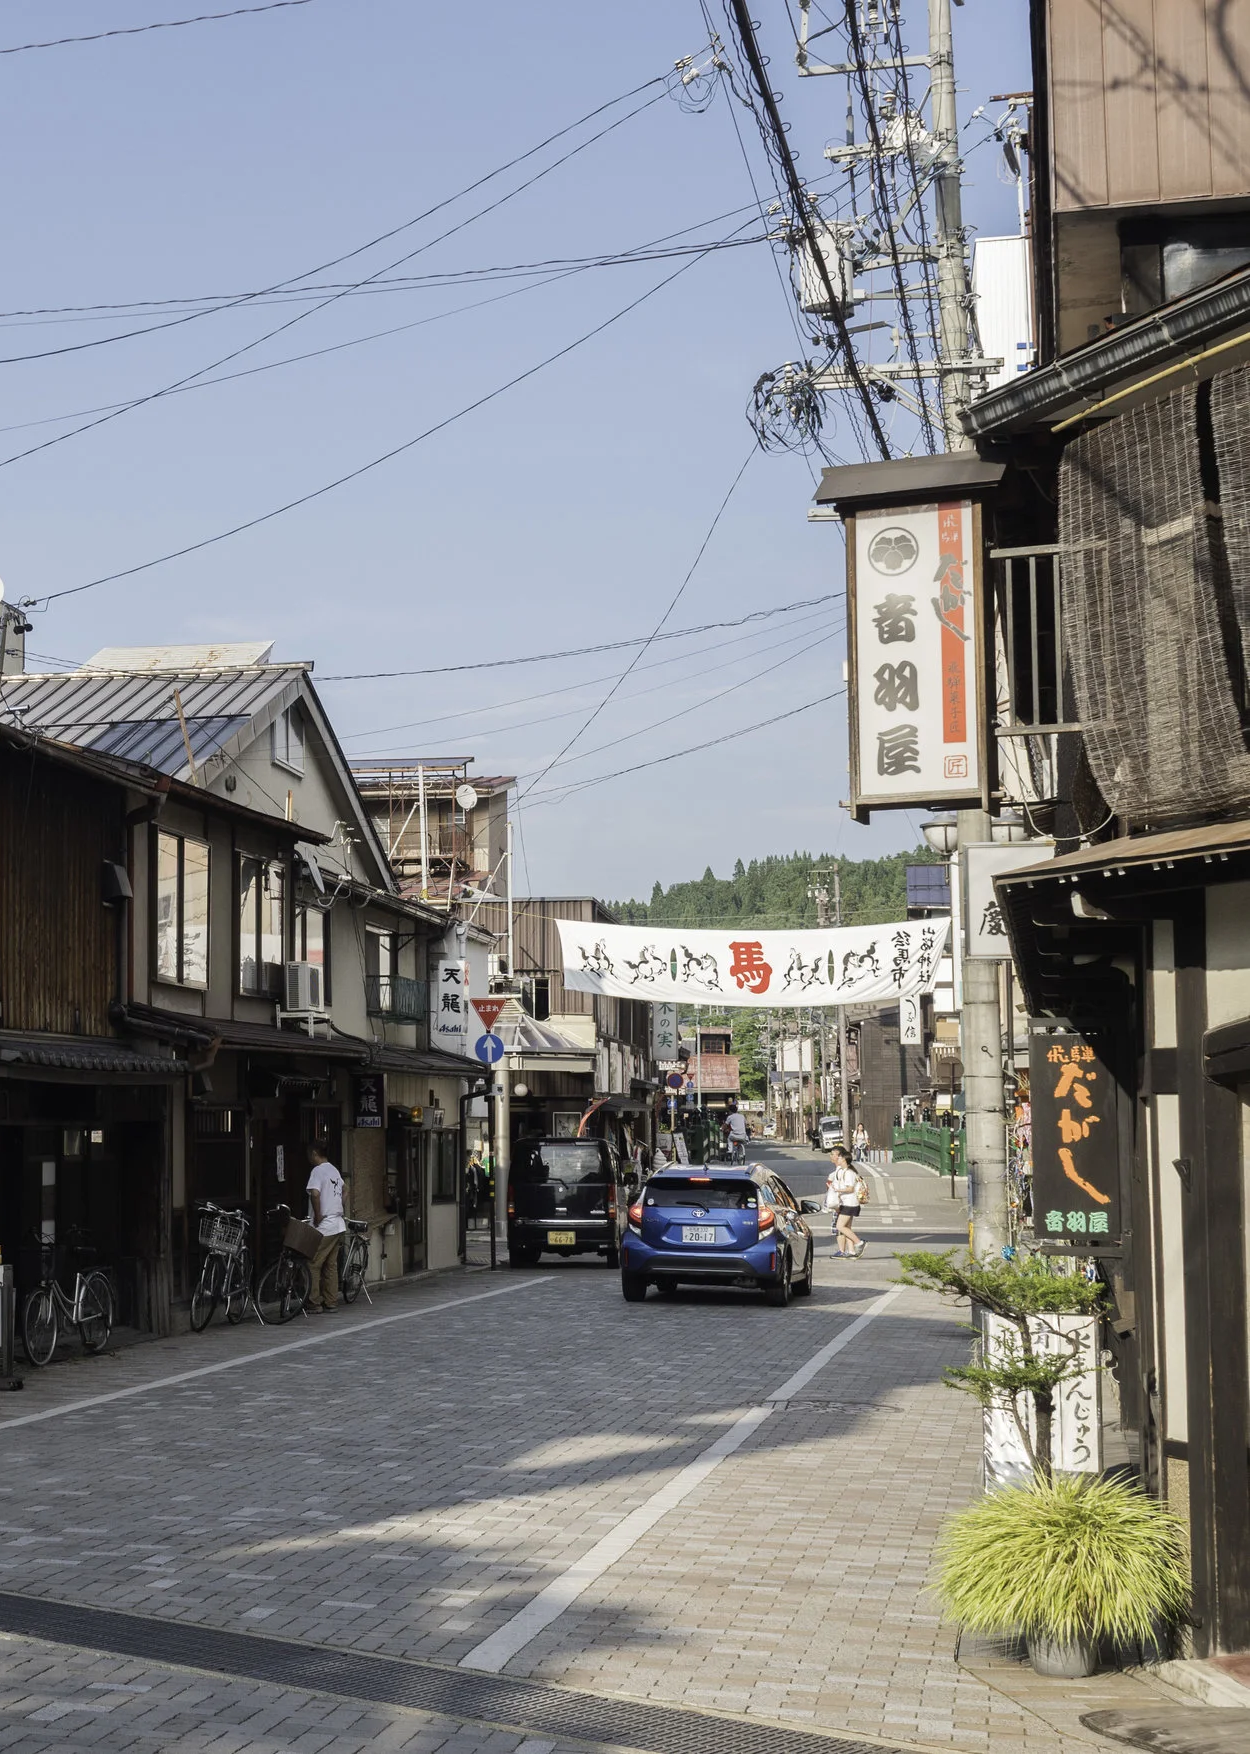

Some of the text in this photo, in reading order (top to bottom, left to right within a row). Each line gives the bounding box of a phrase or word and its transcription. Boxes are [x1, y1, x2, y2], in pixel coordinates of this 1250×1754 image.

[931, 553, 972, 641] だがし
[873, 593, 921, 777] 音羽屋
[946, 757, 965, 776] 匠
[729, 941, 773, 994] 馬
[441, 968, 461, 1014] 天龍
[478, 1004, 500, 1013] 止まれ
[439, 1024, 462, 1033] Asahi
[1046, 1045, 1096, 1063] 飛騨
[360, 1078, 378, 1113] 天龍
[358, 1117, 380, 1126] Asahi
[1054, 1062, 1111, 1204] だがし
[1045, 1210, 1109, 1233] 音羽屋
